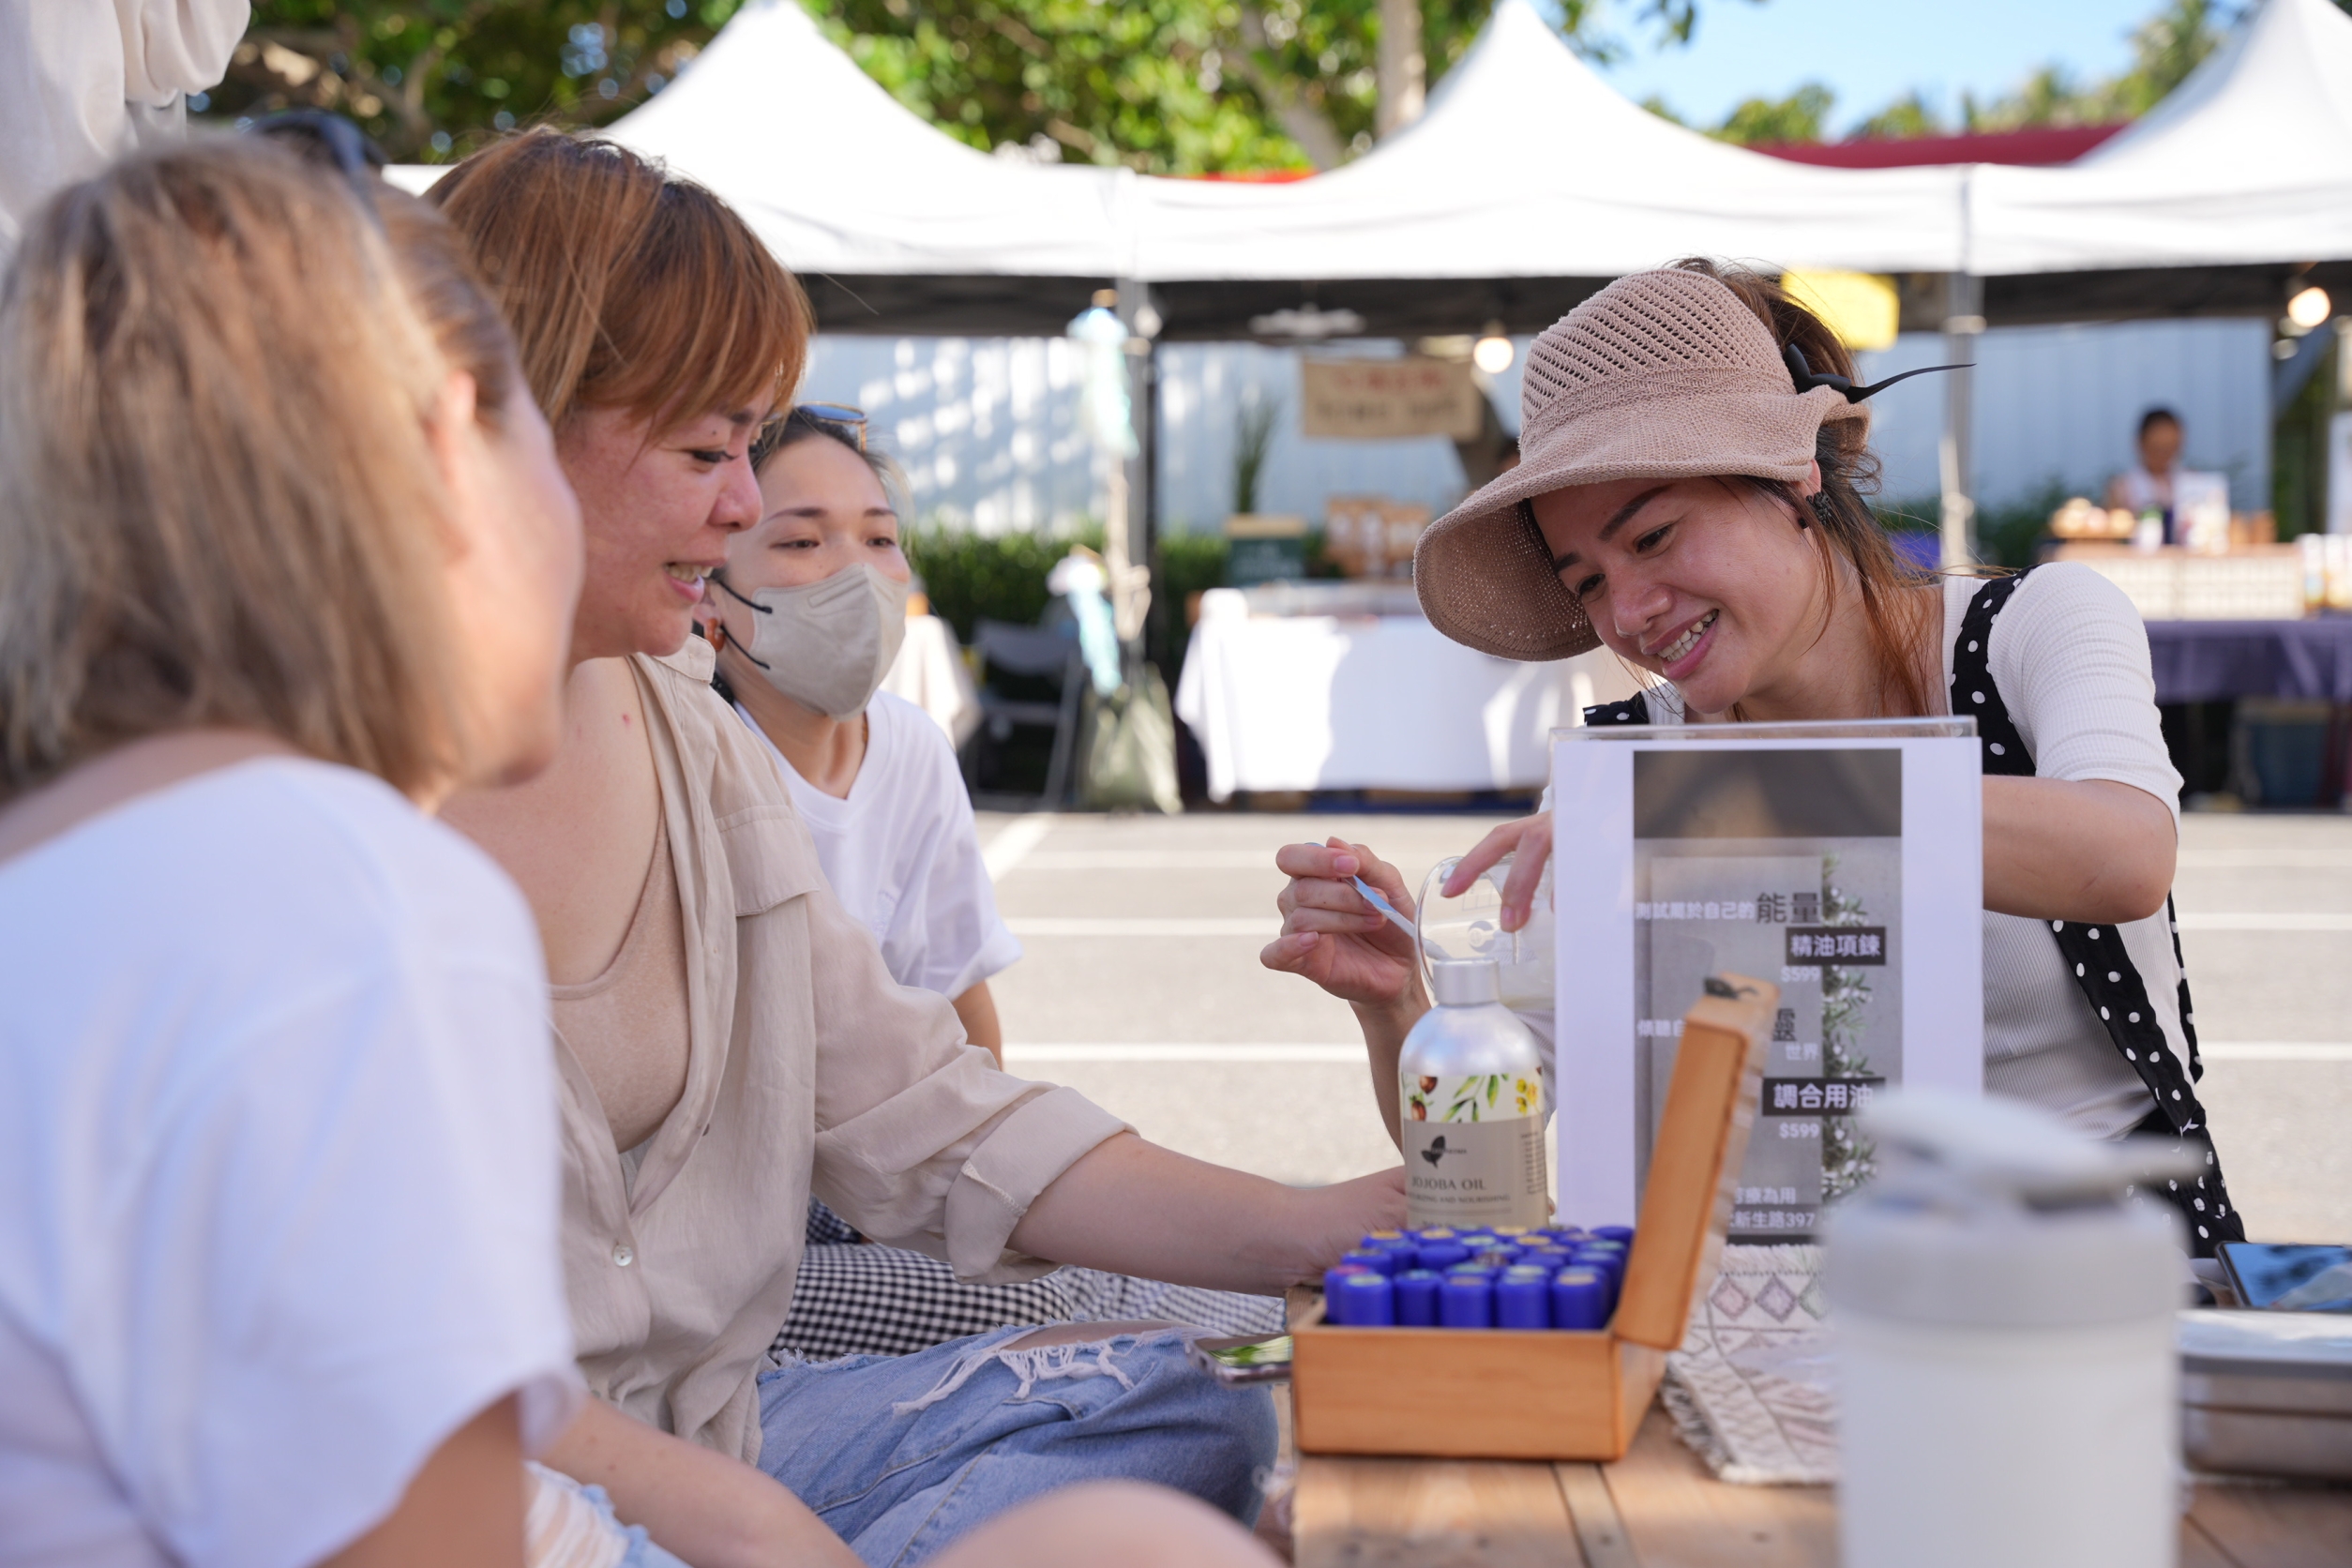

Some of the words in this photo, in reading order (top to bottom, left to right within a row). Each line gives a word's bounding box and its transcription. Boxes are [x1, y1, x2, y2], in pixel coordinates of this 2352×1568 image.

[1790, 934, 1881, 957] 精油項鍊
[1782, 966, 1820, 982] $599
[1786, 1043, 1819, 1061] 世界
[1773, 1083, 1874, 1108] 調合用油
[1779, 1123, 1819, 1138] $599
[1411, 1176, 1457, 1190] JOJOBA
[1461, 1178, 1487, 1191] OIL
[1730, 1211, 1816, 1229] 新生路397
